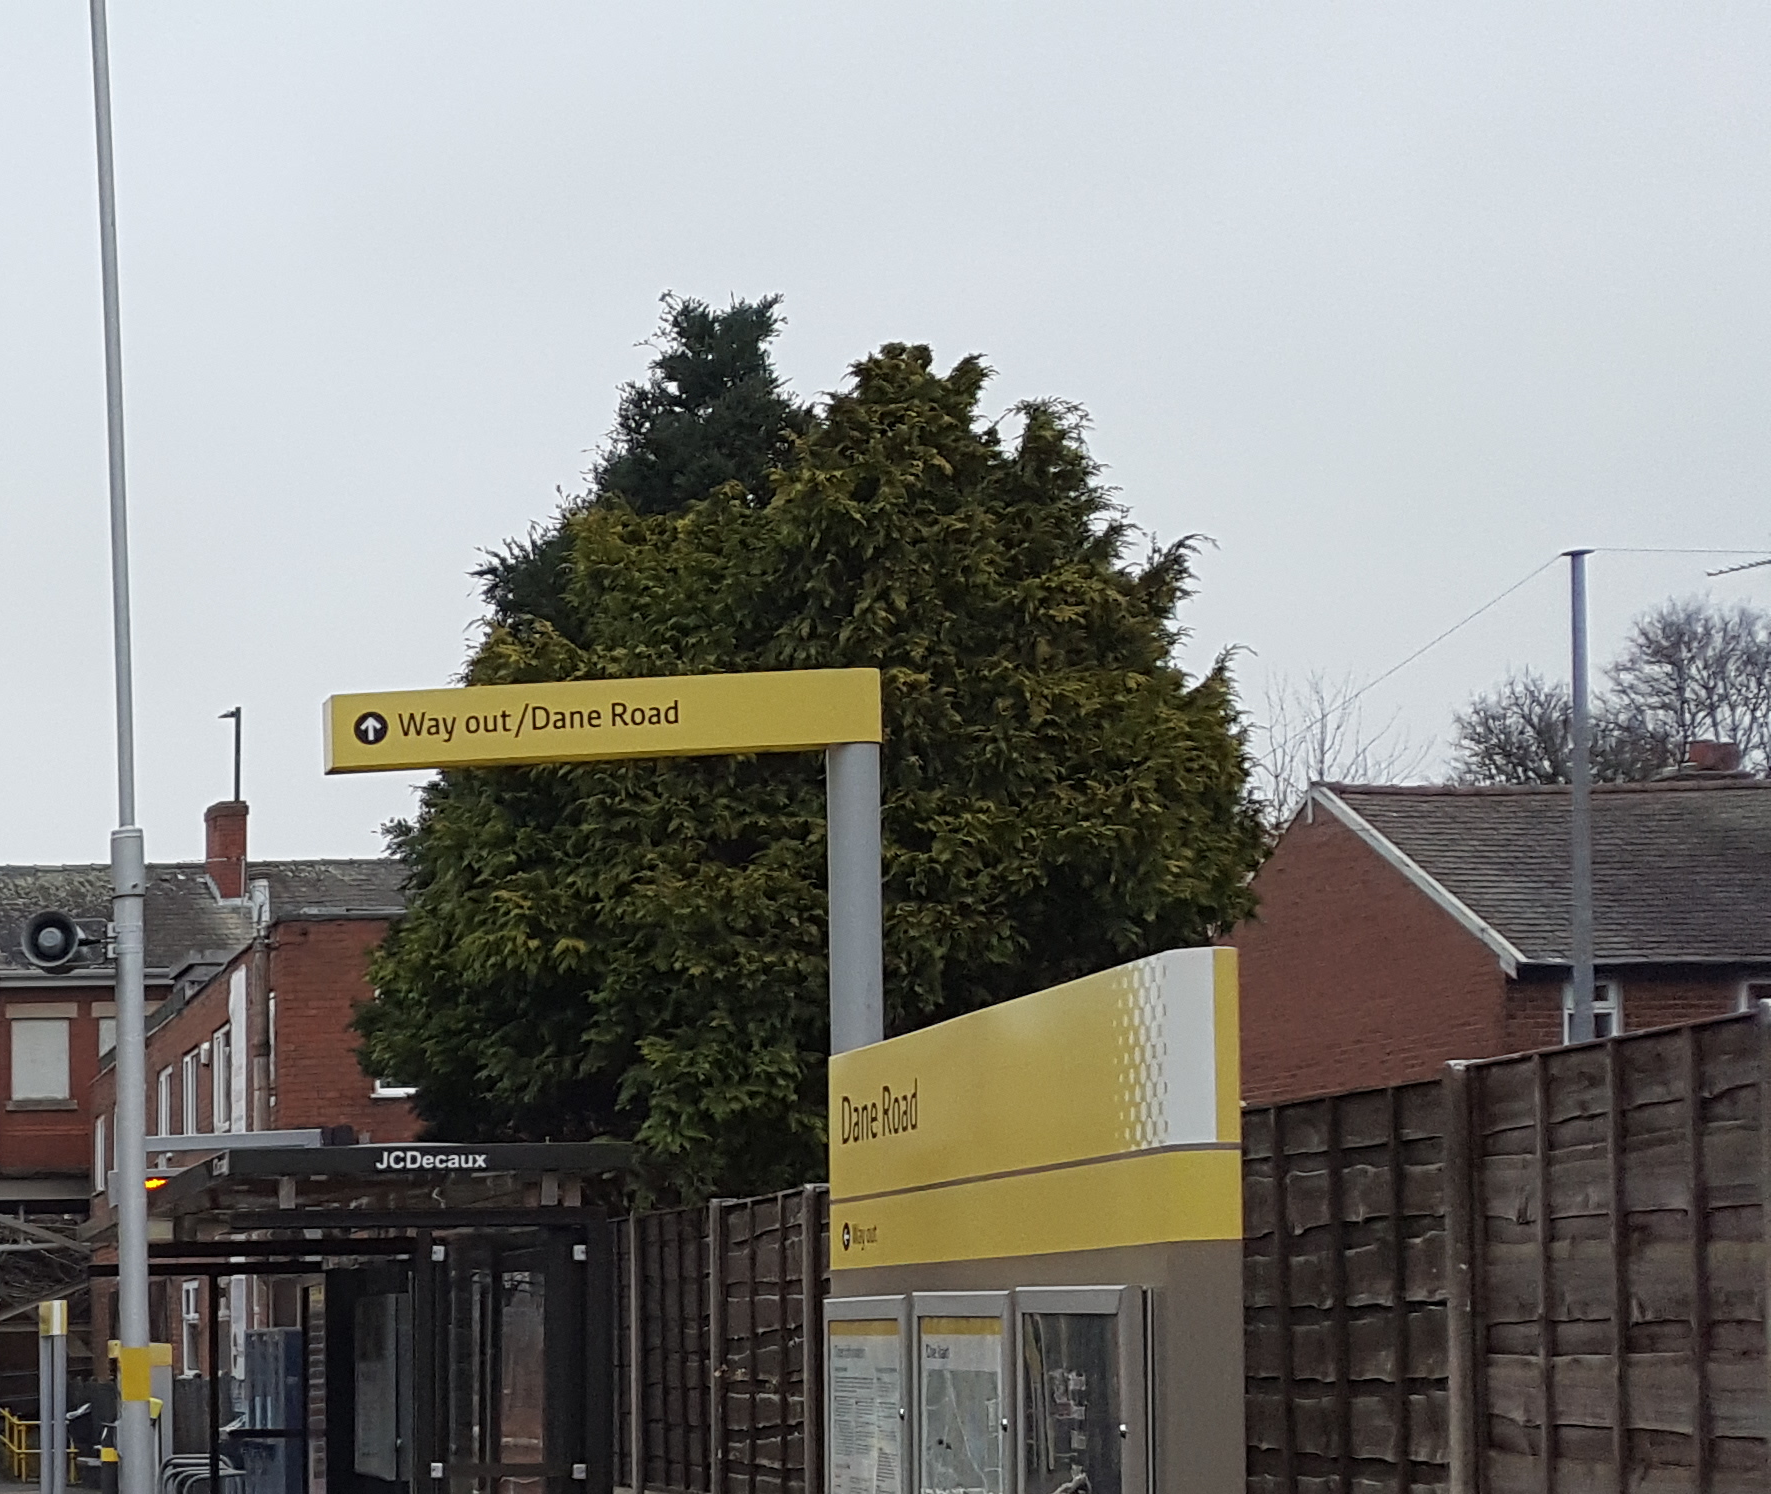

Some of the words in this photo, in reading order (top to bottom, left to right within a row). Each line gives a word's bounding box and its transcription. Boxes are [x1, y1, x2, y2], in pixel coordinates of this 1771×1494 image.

[397, 711, 457, 743] Way
[610, 699, 680, 727] Road
[841, 1095, 879, 1145] Dane
[882, 1077, 918, 1137] Road
[375, 1150, 487, 1169] JCDecaux
